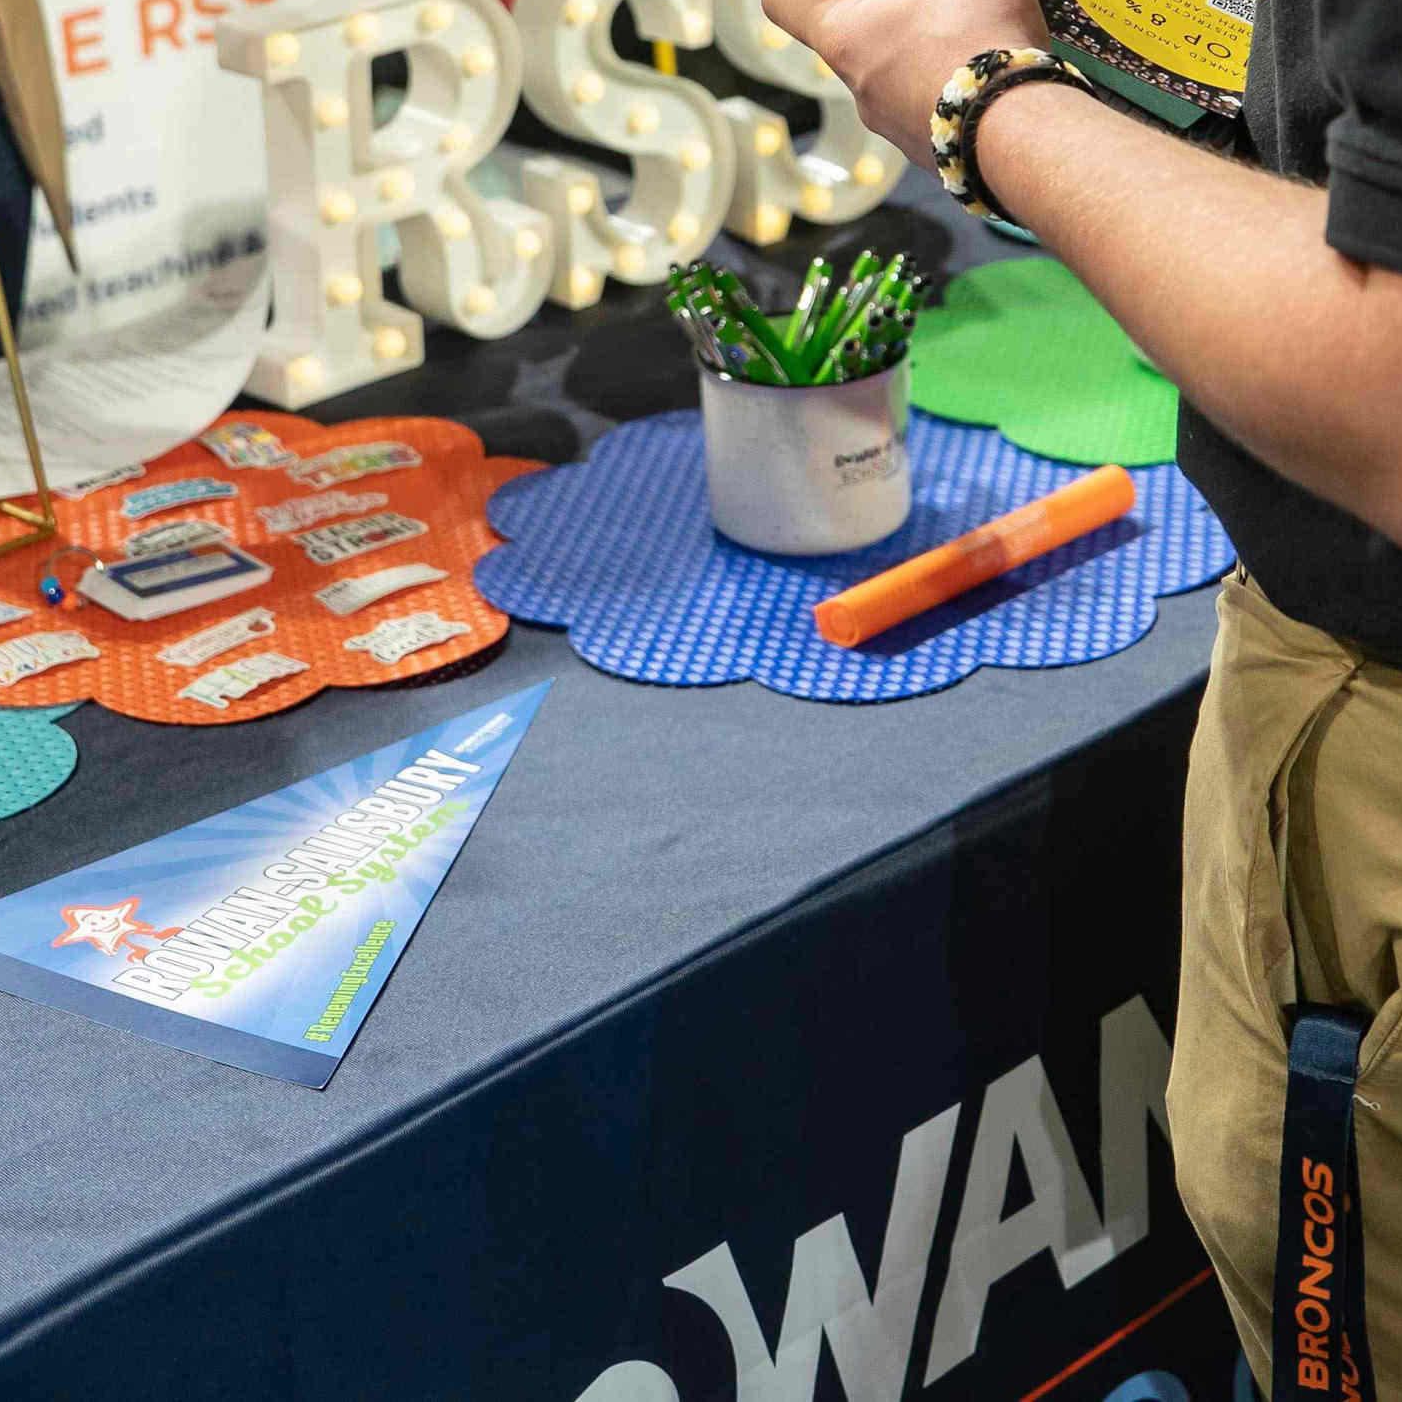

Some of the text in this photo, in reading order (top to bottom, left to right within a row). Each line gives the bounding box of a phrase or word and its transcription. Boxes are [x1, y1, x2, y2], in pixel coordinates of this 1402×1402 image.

[1089, 1, 1243, 80] ANKED AMONG THE
[1164, 1, 1238, 41] DISTRICTS
[1183, 33, 1250, 68] OP
[112, 749, 485, 1000] ROWAN-SALISBURY
[187, 797, 472, 999] School System
[303, 919, 397, 1043] #RenewingExcellence
[1293, 1156, 1336, 1391] BRONCOS
